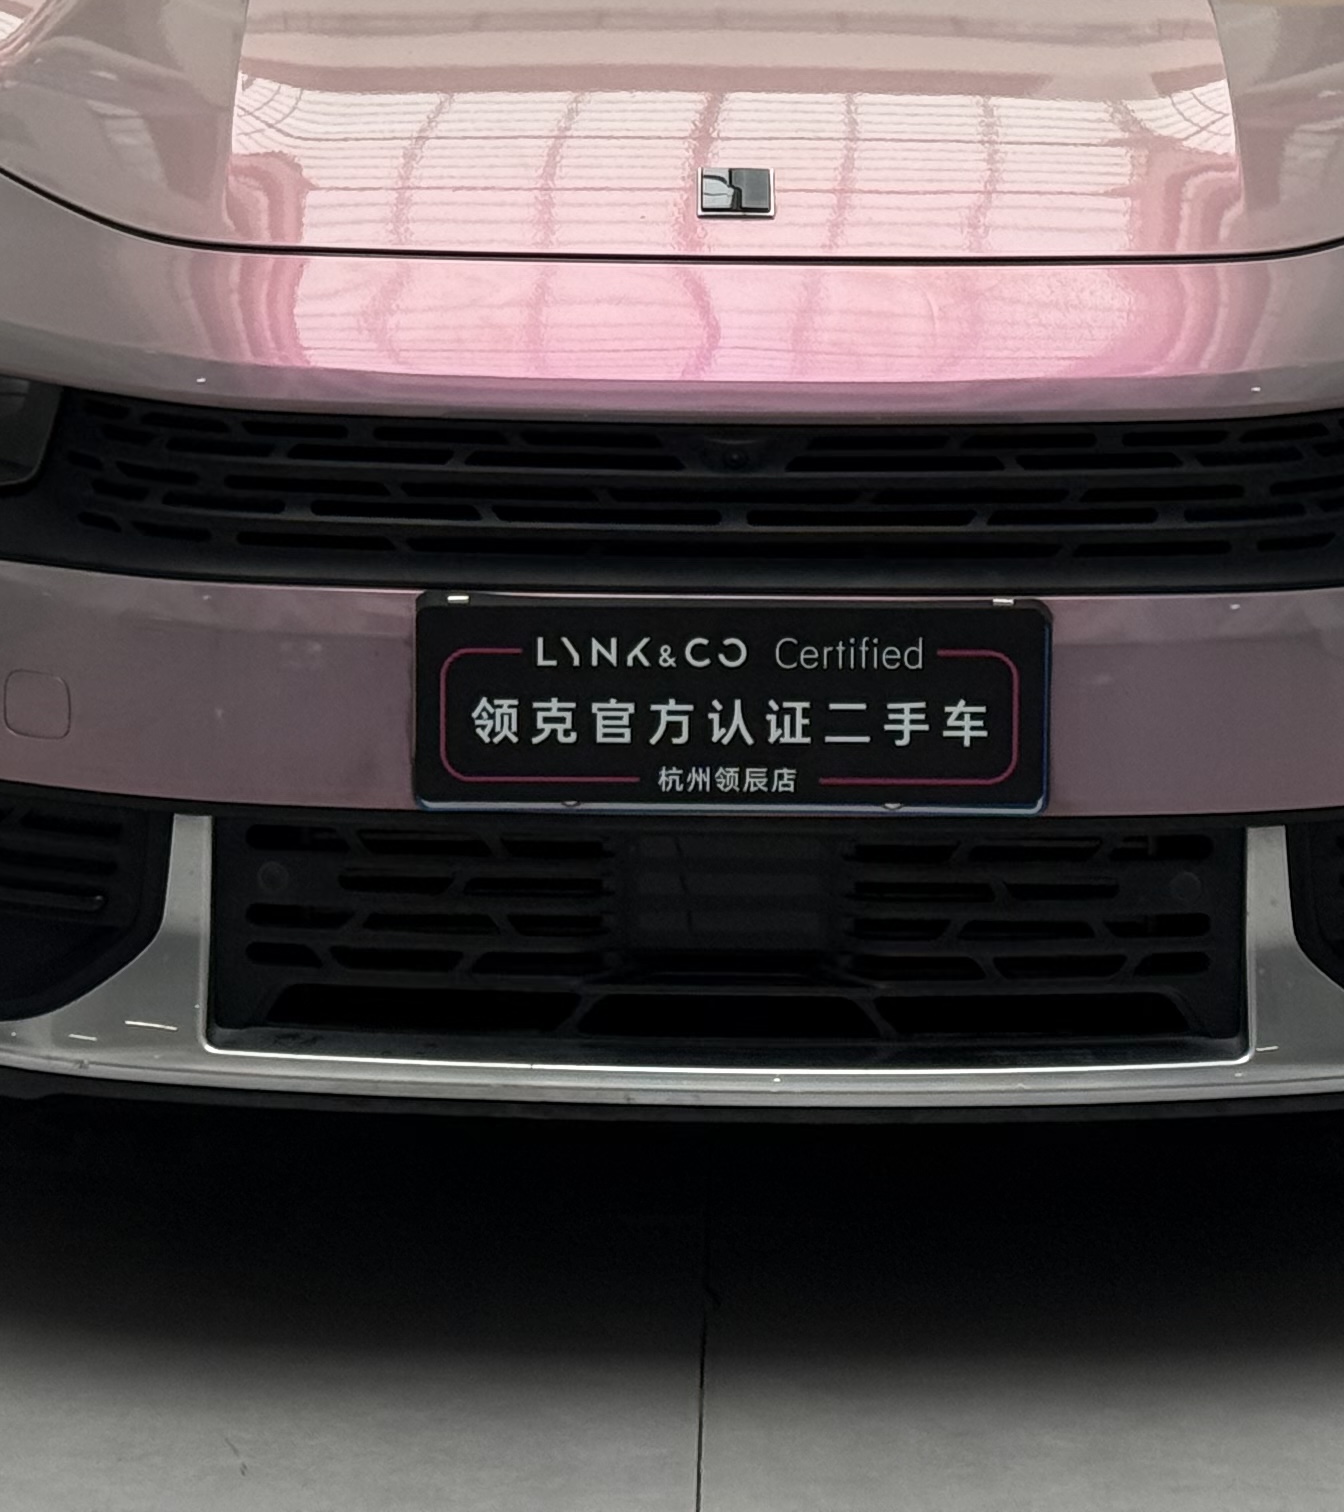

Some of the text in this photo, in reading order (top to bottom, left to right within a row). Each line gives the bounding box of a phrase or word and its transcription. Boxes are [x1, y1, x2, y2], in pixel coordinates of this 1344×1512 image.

[535, 636, 923, 670] LYNK&CO Certified
[471, 696, 989, 748] 领克官方认证二手车
[657, 766, 798, 793] 杭州领辰店
